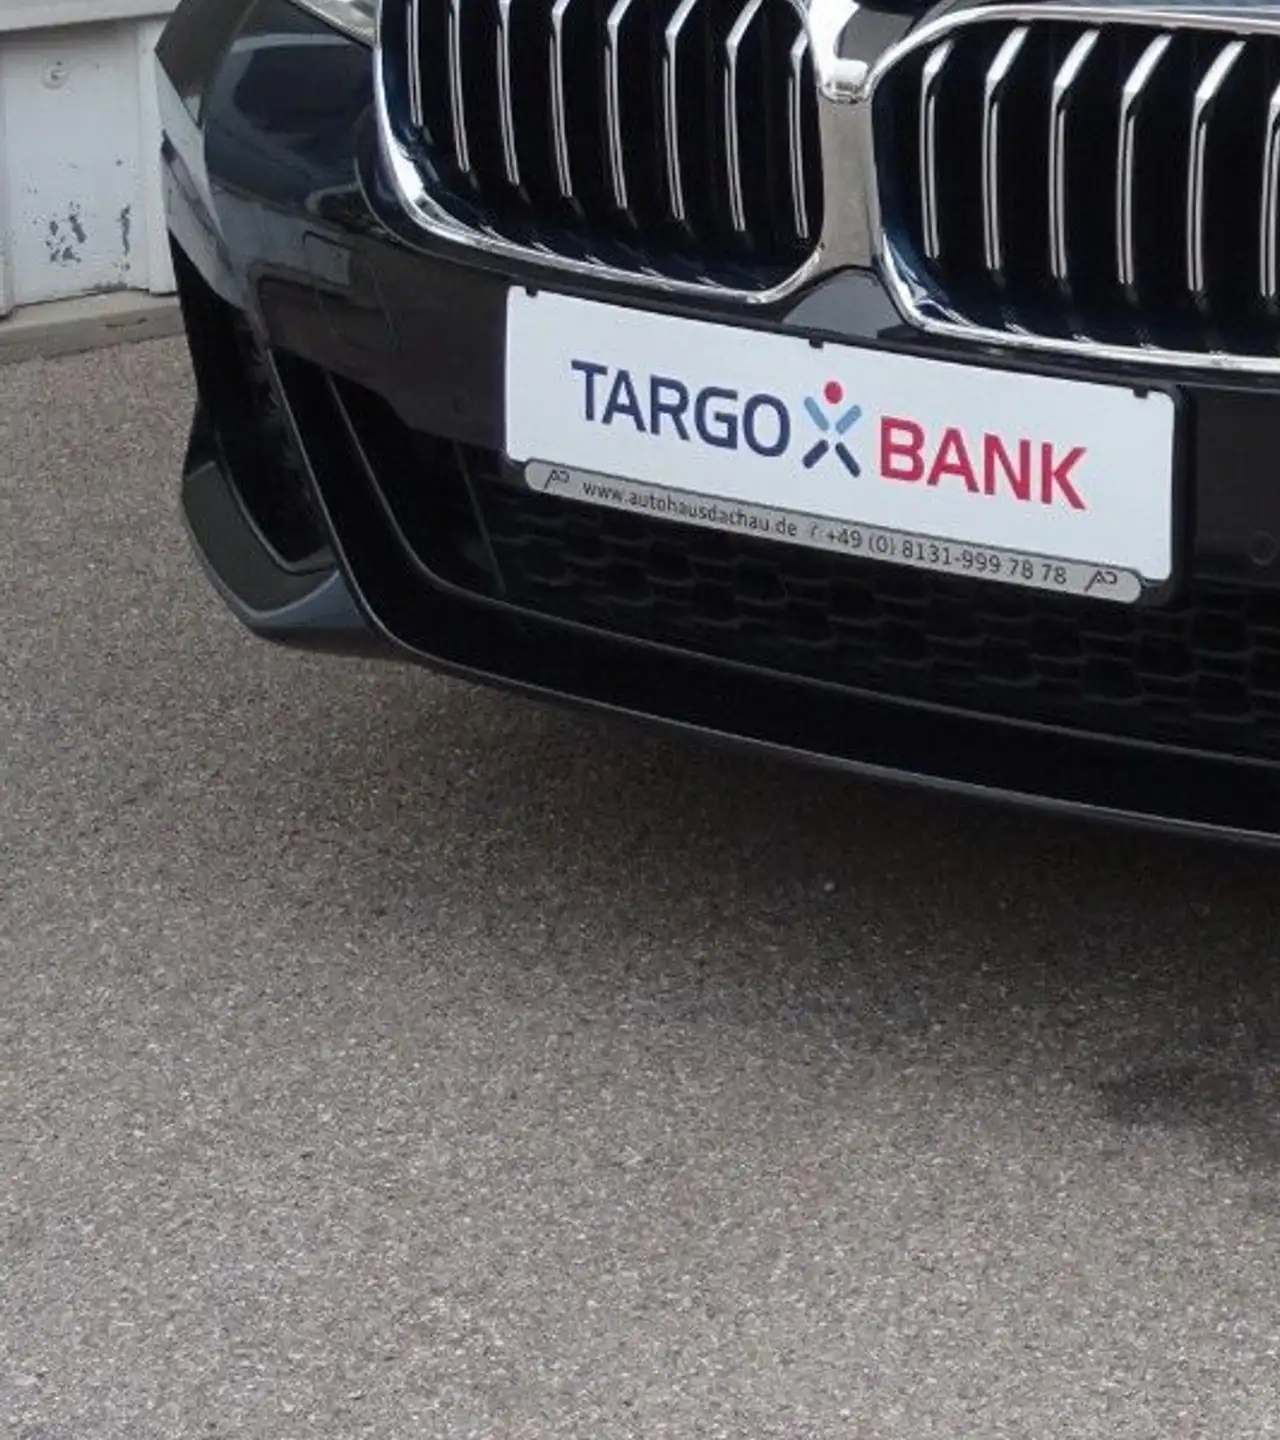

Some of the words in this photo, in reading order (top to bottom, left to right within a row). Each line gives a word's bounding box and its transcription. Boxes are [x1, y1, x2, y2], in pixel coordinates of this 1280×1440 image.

[571, 358, 791, 458] TARGO
[879, 415, 1087, 511] BANK
[583, 479, 798, 537] www.autohausdachau.de
[826, 527, 863, 549] +49
[868, 533, 896, 556] (0)
[902, 539, 1001, 575] 8131-999
[1009, 558, 1034, 581] 78
[1042, 563, 1067, 586] 78
